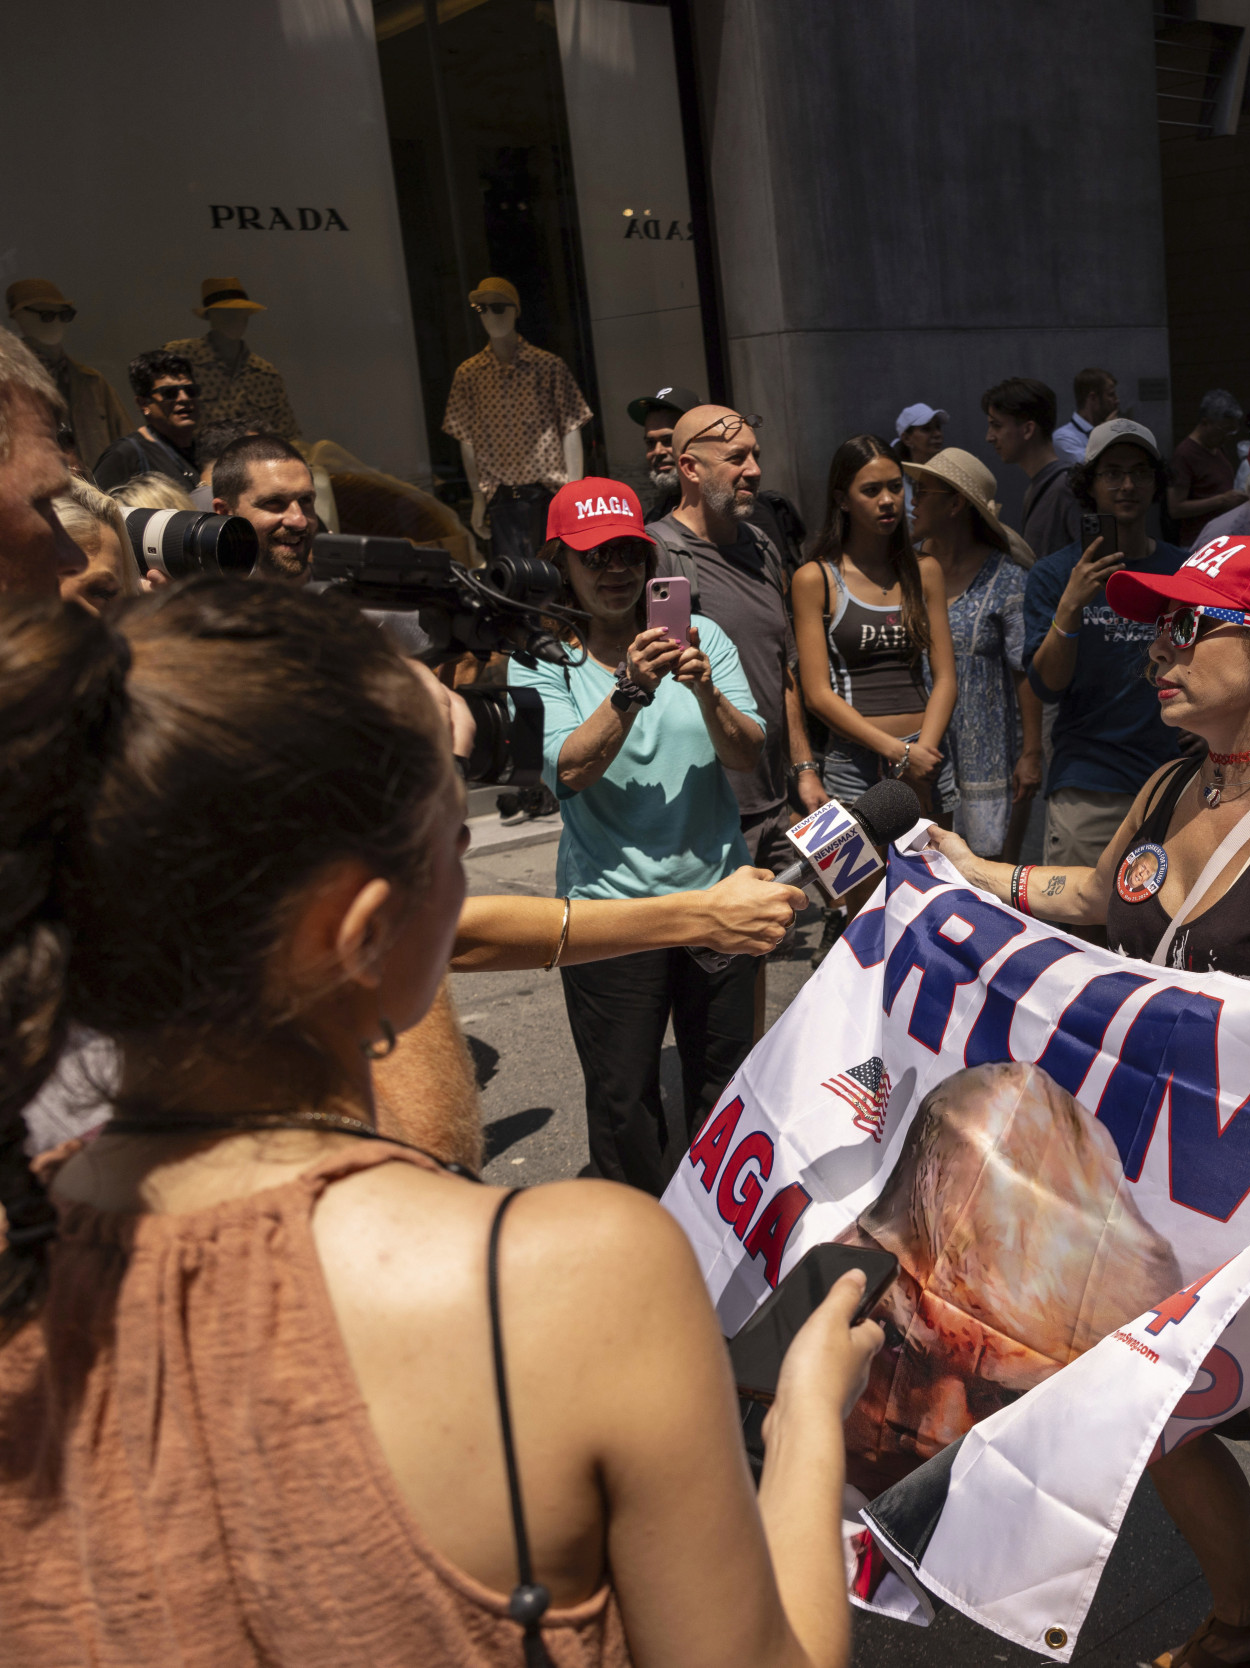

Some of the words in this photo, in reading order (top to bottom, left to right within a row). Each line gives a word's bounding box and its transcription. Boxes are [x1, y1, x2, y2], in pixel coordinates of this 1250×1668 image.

[209, 204, 350, 231] PRADA
[575, 496, 634, 520] MAGA
[1181, 535, 1246, 578] GA
[791, 804, 833, 832] NEWSMAX
[814, 828, 858, 862] NEWSMAX
[1018, 868, 1027, 897] TRUMP
[689, 1080, 813, 1291] AGA
